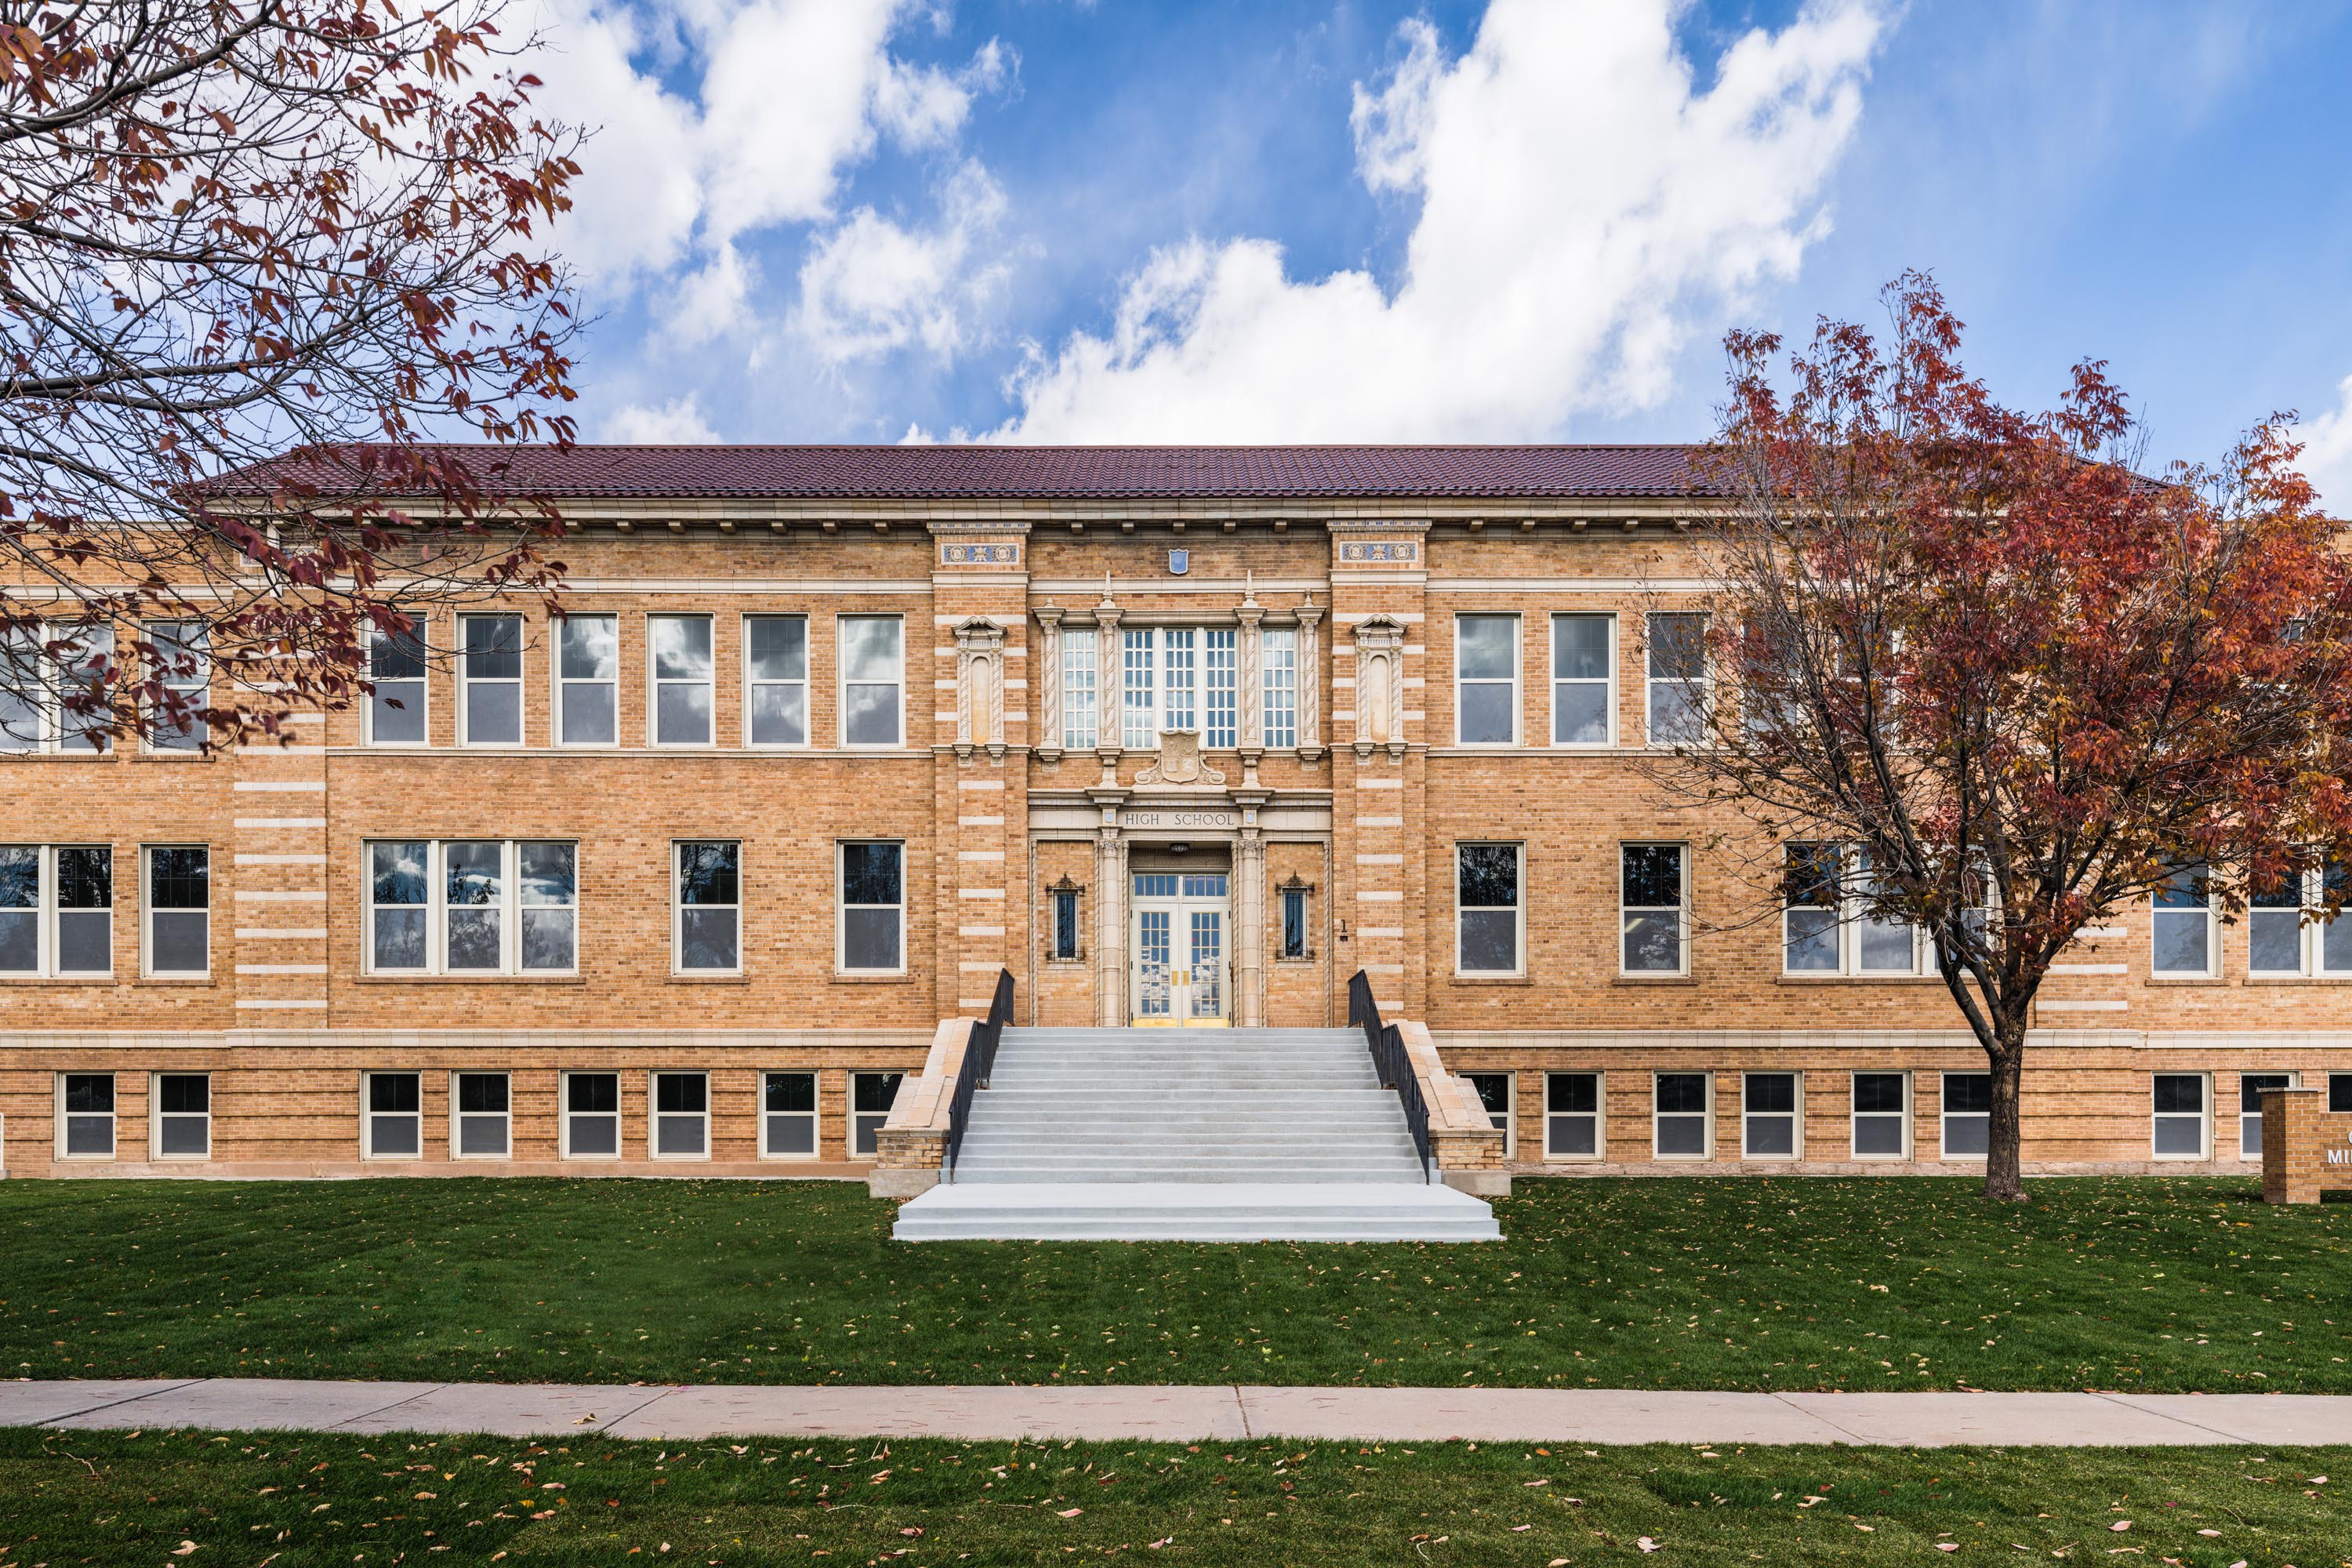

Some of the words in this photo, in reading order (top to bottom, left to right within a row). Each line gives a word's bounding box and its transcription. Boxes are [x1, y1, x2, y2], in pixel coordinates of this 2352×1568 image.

[1126, 814, 1159, 825] HIGH
[1174, 814, 1234, 826] SCHOOL
[2328, 1149, 2352, 1163] MI
